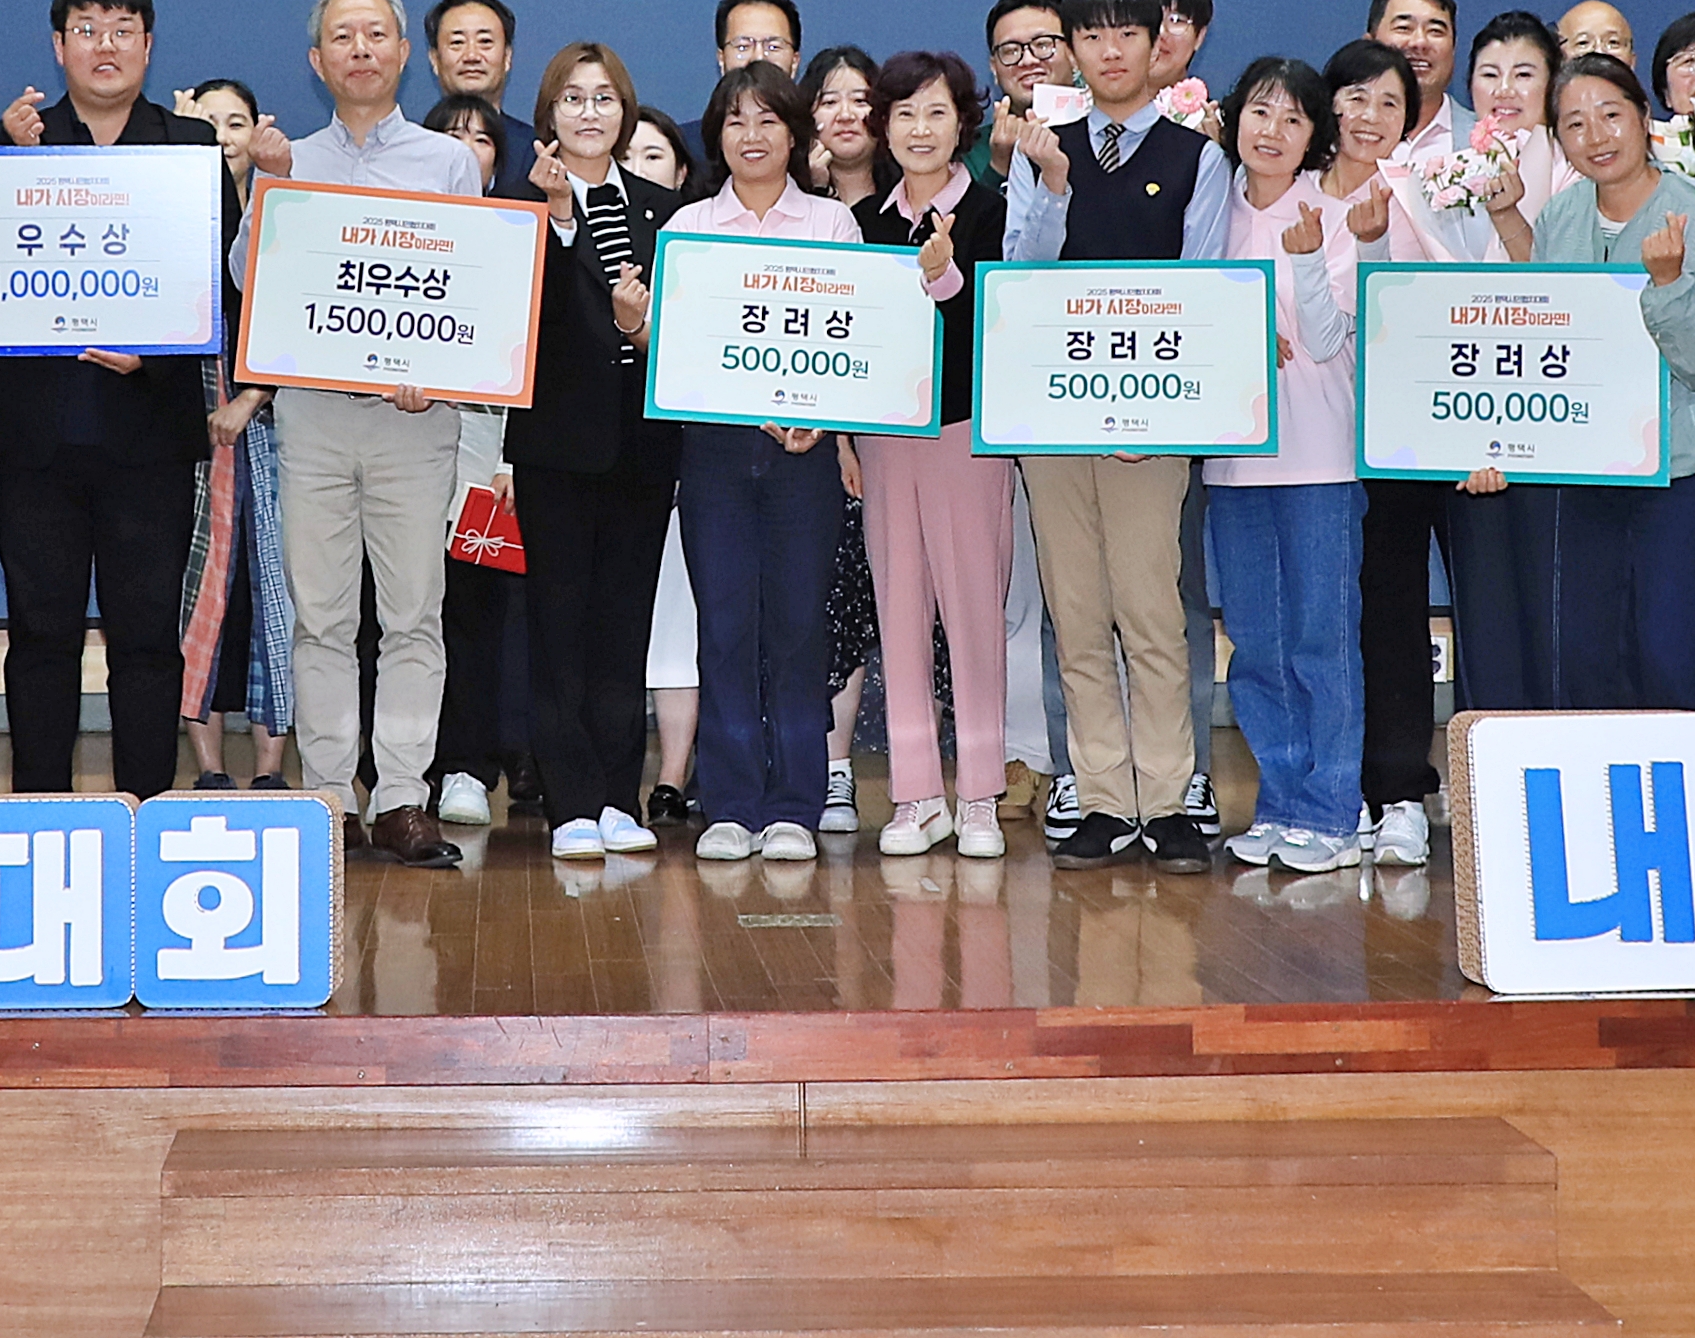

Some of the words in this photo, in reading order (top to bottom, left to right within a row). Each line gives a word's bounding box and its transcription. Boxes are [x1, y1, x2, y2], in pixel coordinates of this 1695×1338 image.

[17, 188, 52, 207] 내가
[341, 226, 377, 246] 내가
[336, 260, 451, 300] 최우수상
[743, 273, 778, 291] 내가
[1067, 299, 1102, 315] 내가
[1450, 307, 1487, 325] 내가
[304, 302, 475, 345] 1,500,000원
[720, 345, 869, 380] 500,000원
[1047, 374, 1201, 402] 500,000원
[1431, 391, 1589, 426] 500,000원
